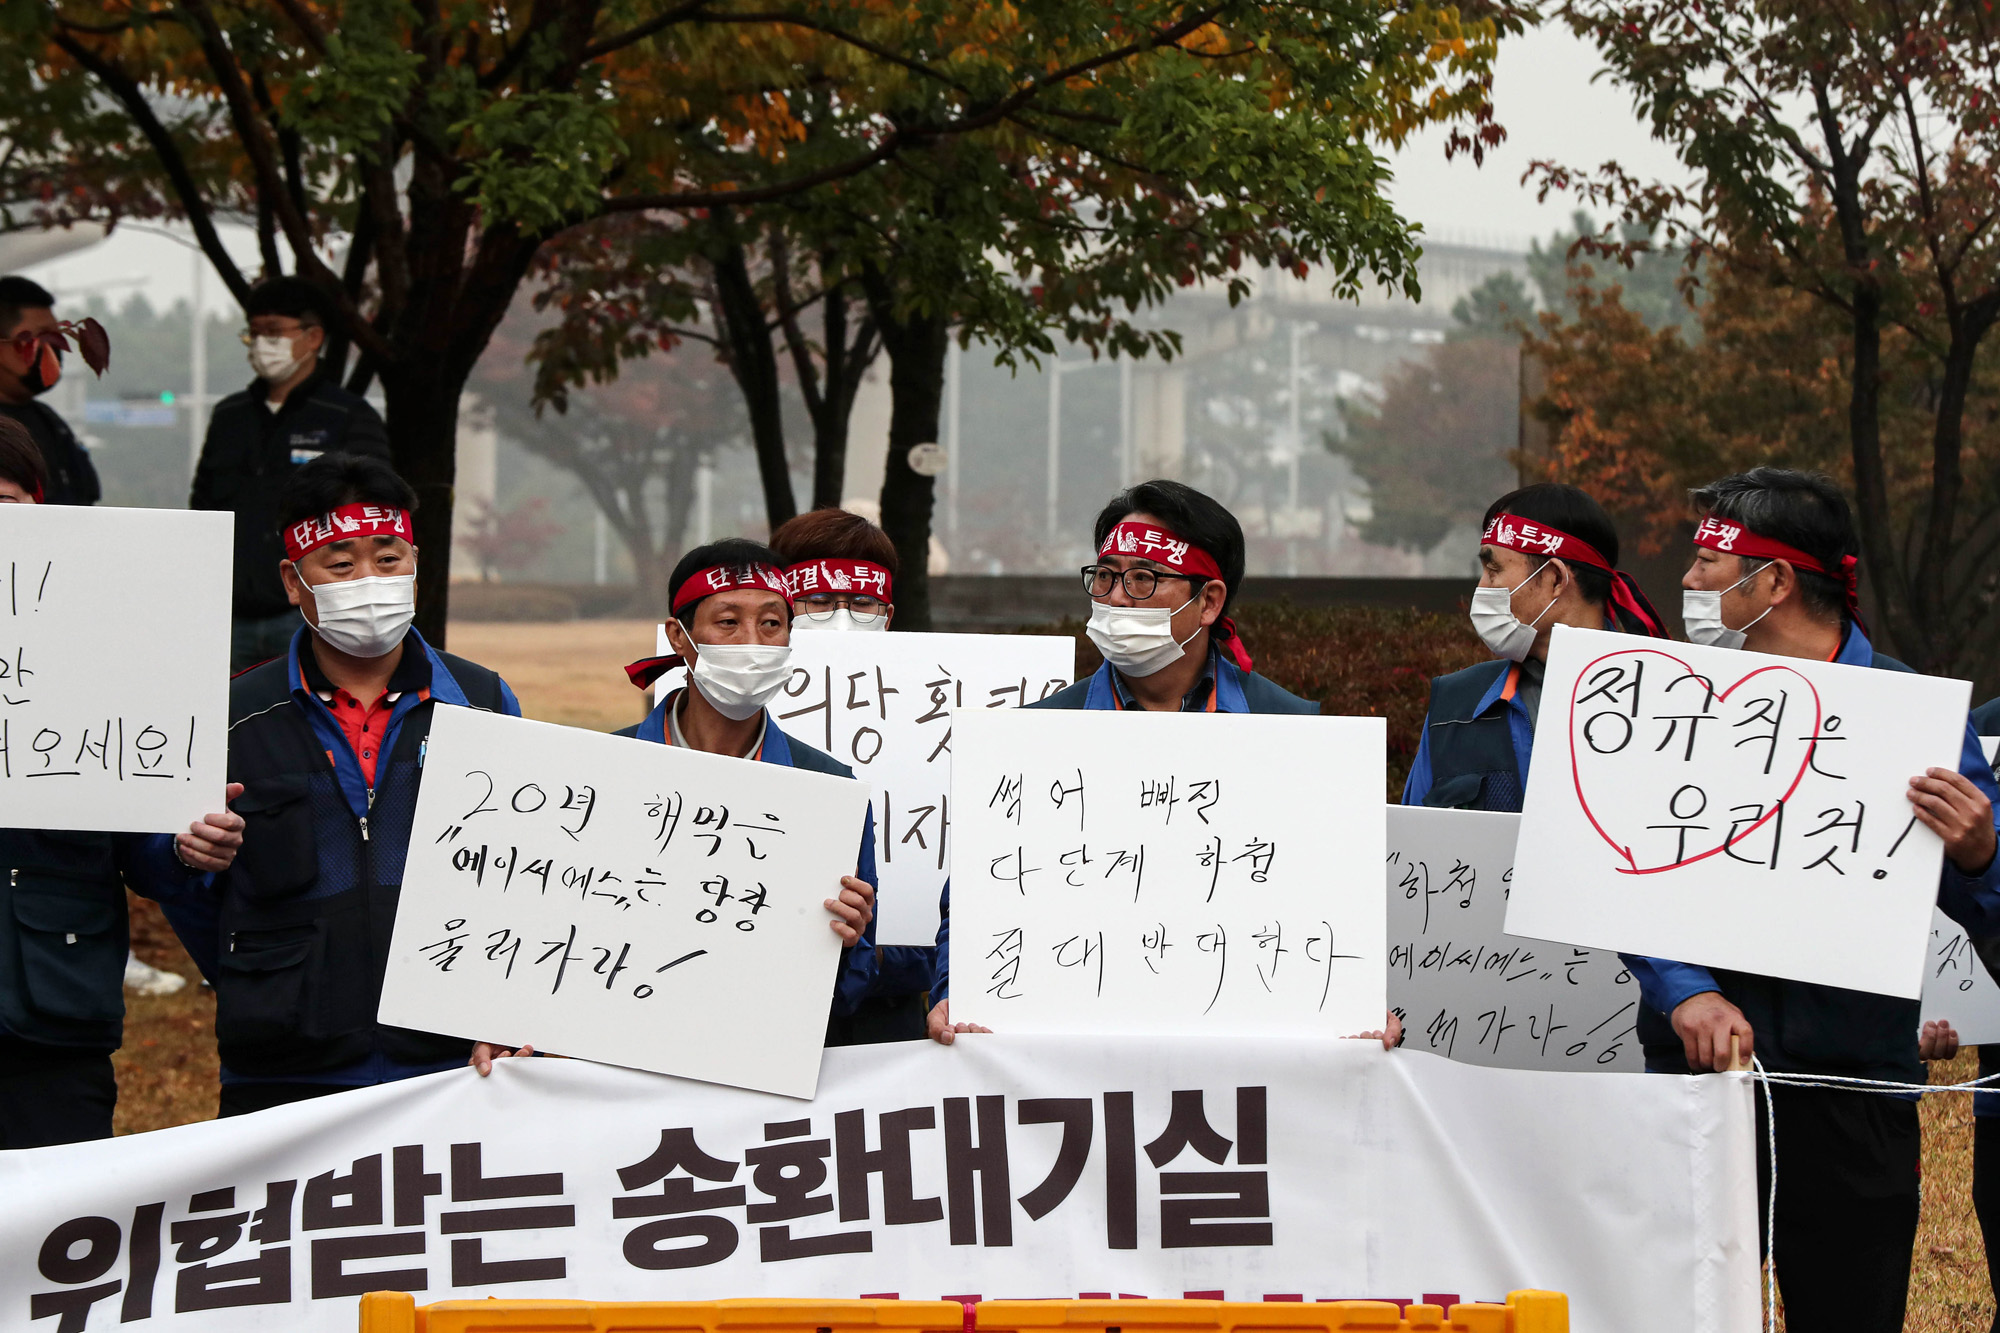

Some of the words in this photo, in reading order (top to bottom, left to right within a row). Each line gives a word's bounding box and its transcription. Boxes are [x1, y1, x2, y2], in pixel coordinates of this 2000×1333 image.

[293, 511, 335, 550] 단결
[361, 506, 405, 533] 투쟁
[1139, 529, 1189, 565] 투쟁
[1516, 524, 1564, 554] 투쟁
[1701, 517, 1741, 550] 투쟁
[785, 564, 818, 595] 단결
[852, 565, 886, 595] 투쟁
[1576, 660, 1848, 780] 정규직은
[465, 770, 597, 842] 20년
[643, 791, 786, 859] 해먹은
[1141, 776, 1219, 824] 빠진
[1196, 836, 1274, 902] 하청
[695, 874, 772, 933] 당장
[30, 1142, 576, 1333] 위협받는
[612, 1086, 1274, 1270] 송환대기실
